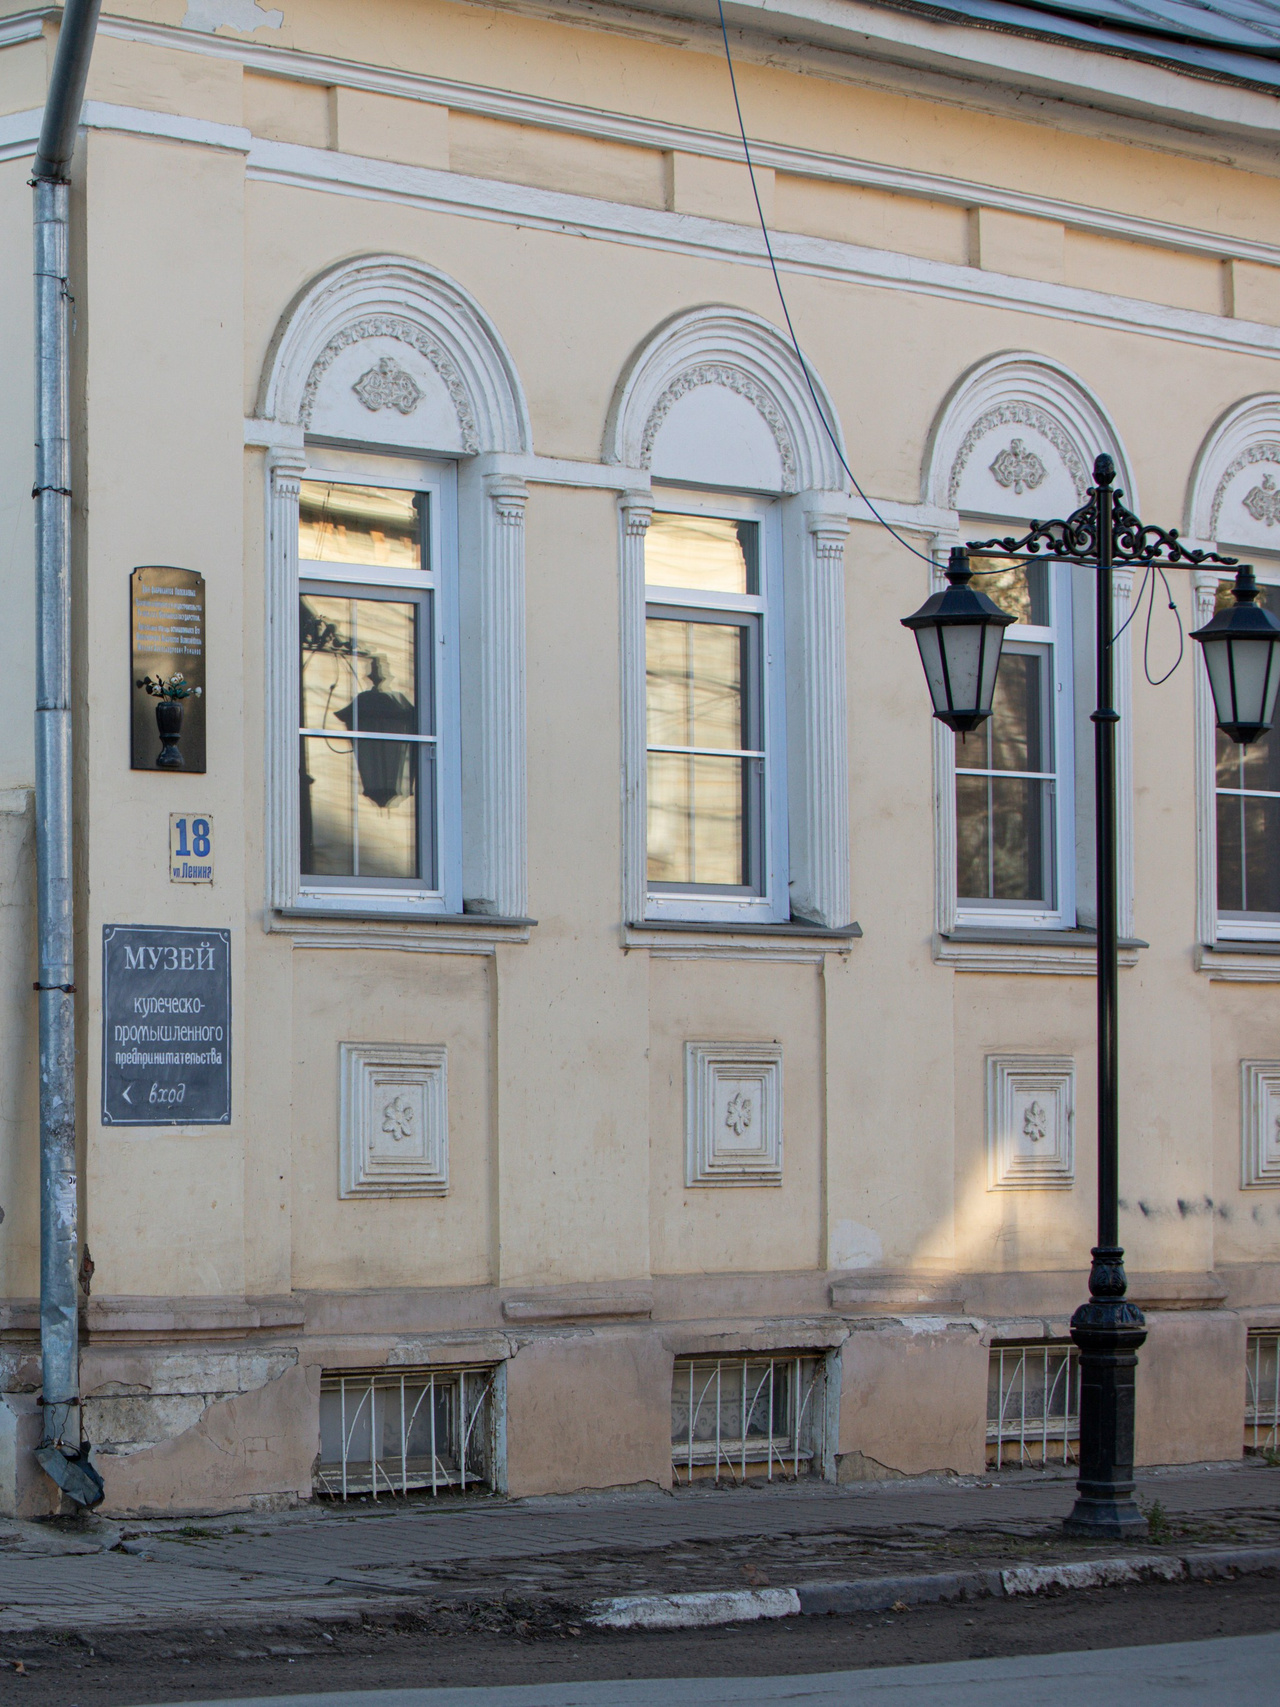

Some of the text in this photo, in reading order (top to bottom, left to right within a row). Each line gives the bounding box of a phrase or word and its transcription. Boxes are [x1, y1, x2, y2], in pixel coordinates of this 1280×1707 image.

[176, 819, 210, 857] 18
[182, 863, 212, 878] Ленина
[124, 942, 215, 970] МУЗЕЙ
[134, 997, 205, 1018] купеческо-
[115, 1025, 223, 1046] промышленного
[116, 1048, 222, 1069] предпринимательства
[149, 1081, 186, 1104] вход
